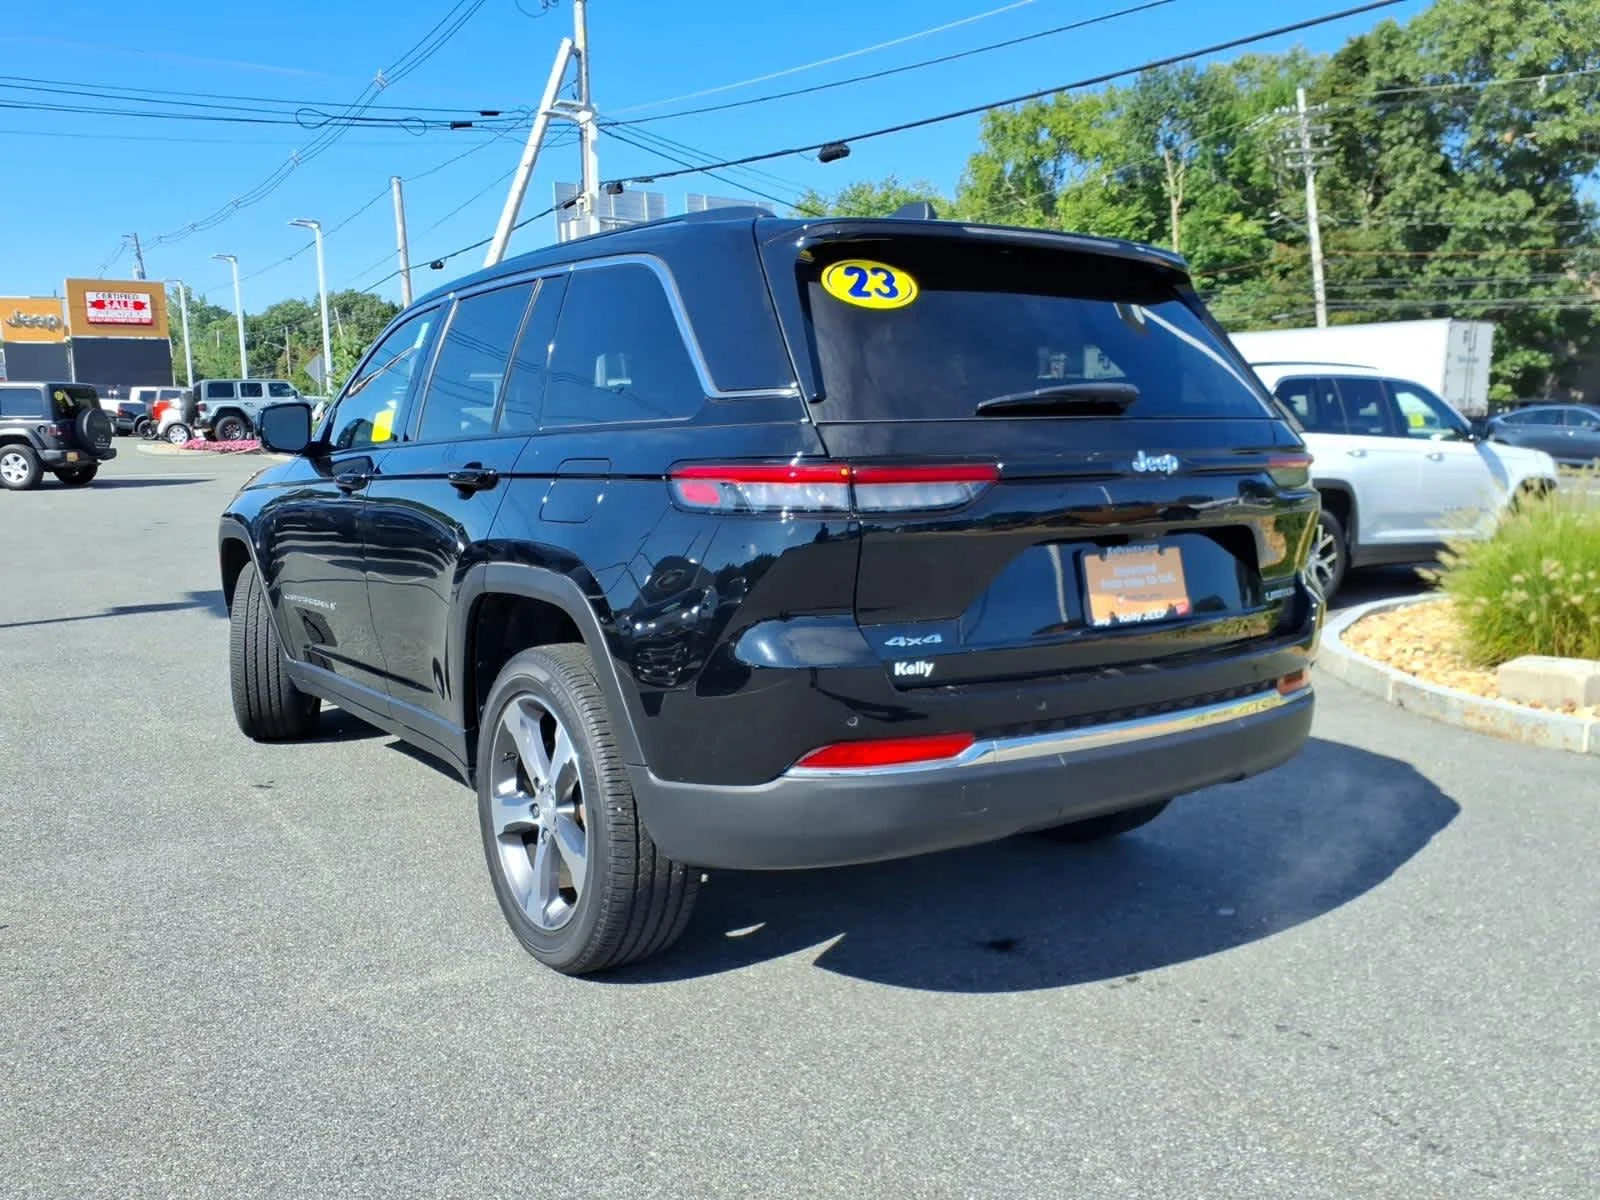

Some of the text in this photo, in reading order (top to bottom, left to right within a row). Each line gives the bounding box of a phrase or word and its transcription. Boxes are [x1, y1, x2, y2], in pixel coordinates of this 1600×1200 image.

[844, 265, 899, 299] 23
[104, 300, 134, 310] SALE
[6, 308, 61, 332] Jeep
[1131, 449, 1179, 476] Jeep
[884, 633, 943, 647] 4x4
[894, 661, 935, 677] Kelly
